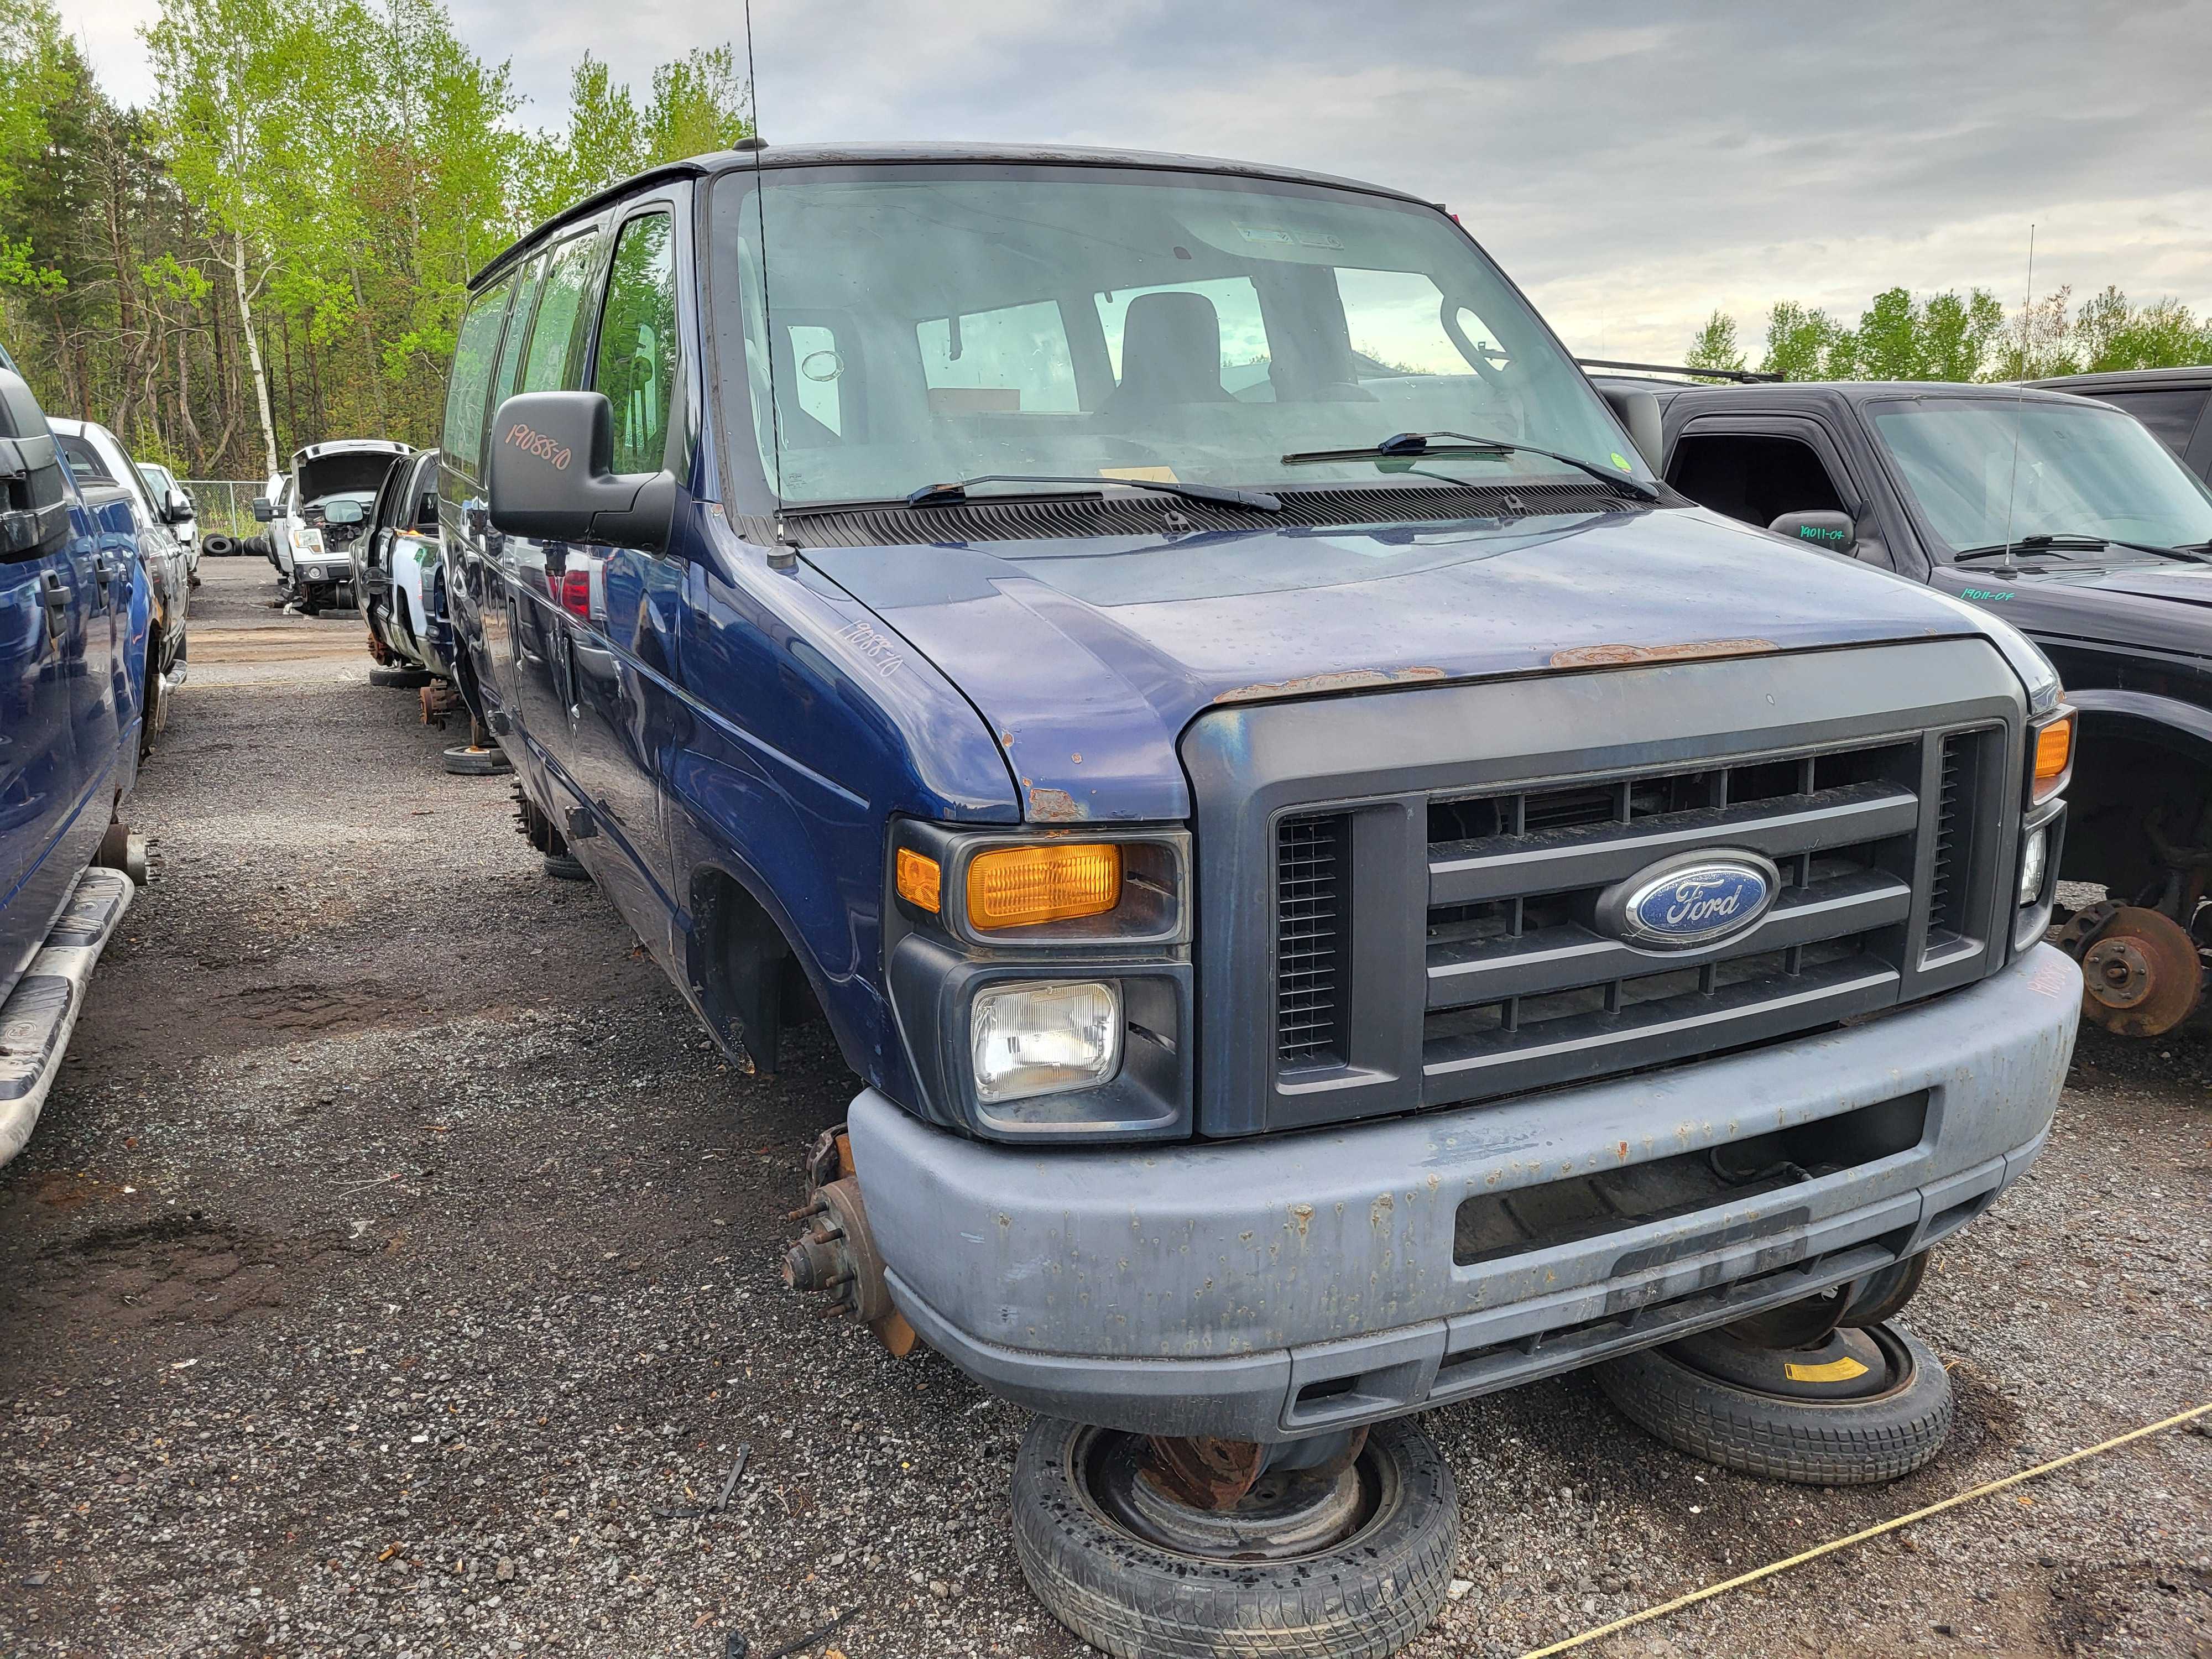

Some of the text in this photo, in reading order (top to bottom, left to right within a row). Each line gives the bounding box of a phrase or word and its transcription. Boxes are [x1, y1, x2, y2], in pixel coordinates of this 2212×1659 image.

[504, 424, 571, 470] 19088-10
[835, 619, 903, 677] 19088-10
[1666, 879, 1743, 924] Ford
